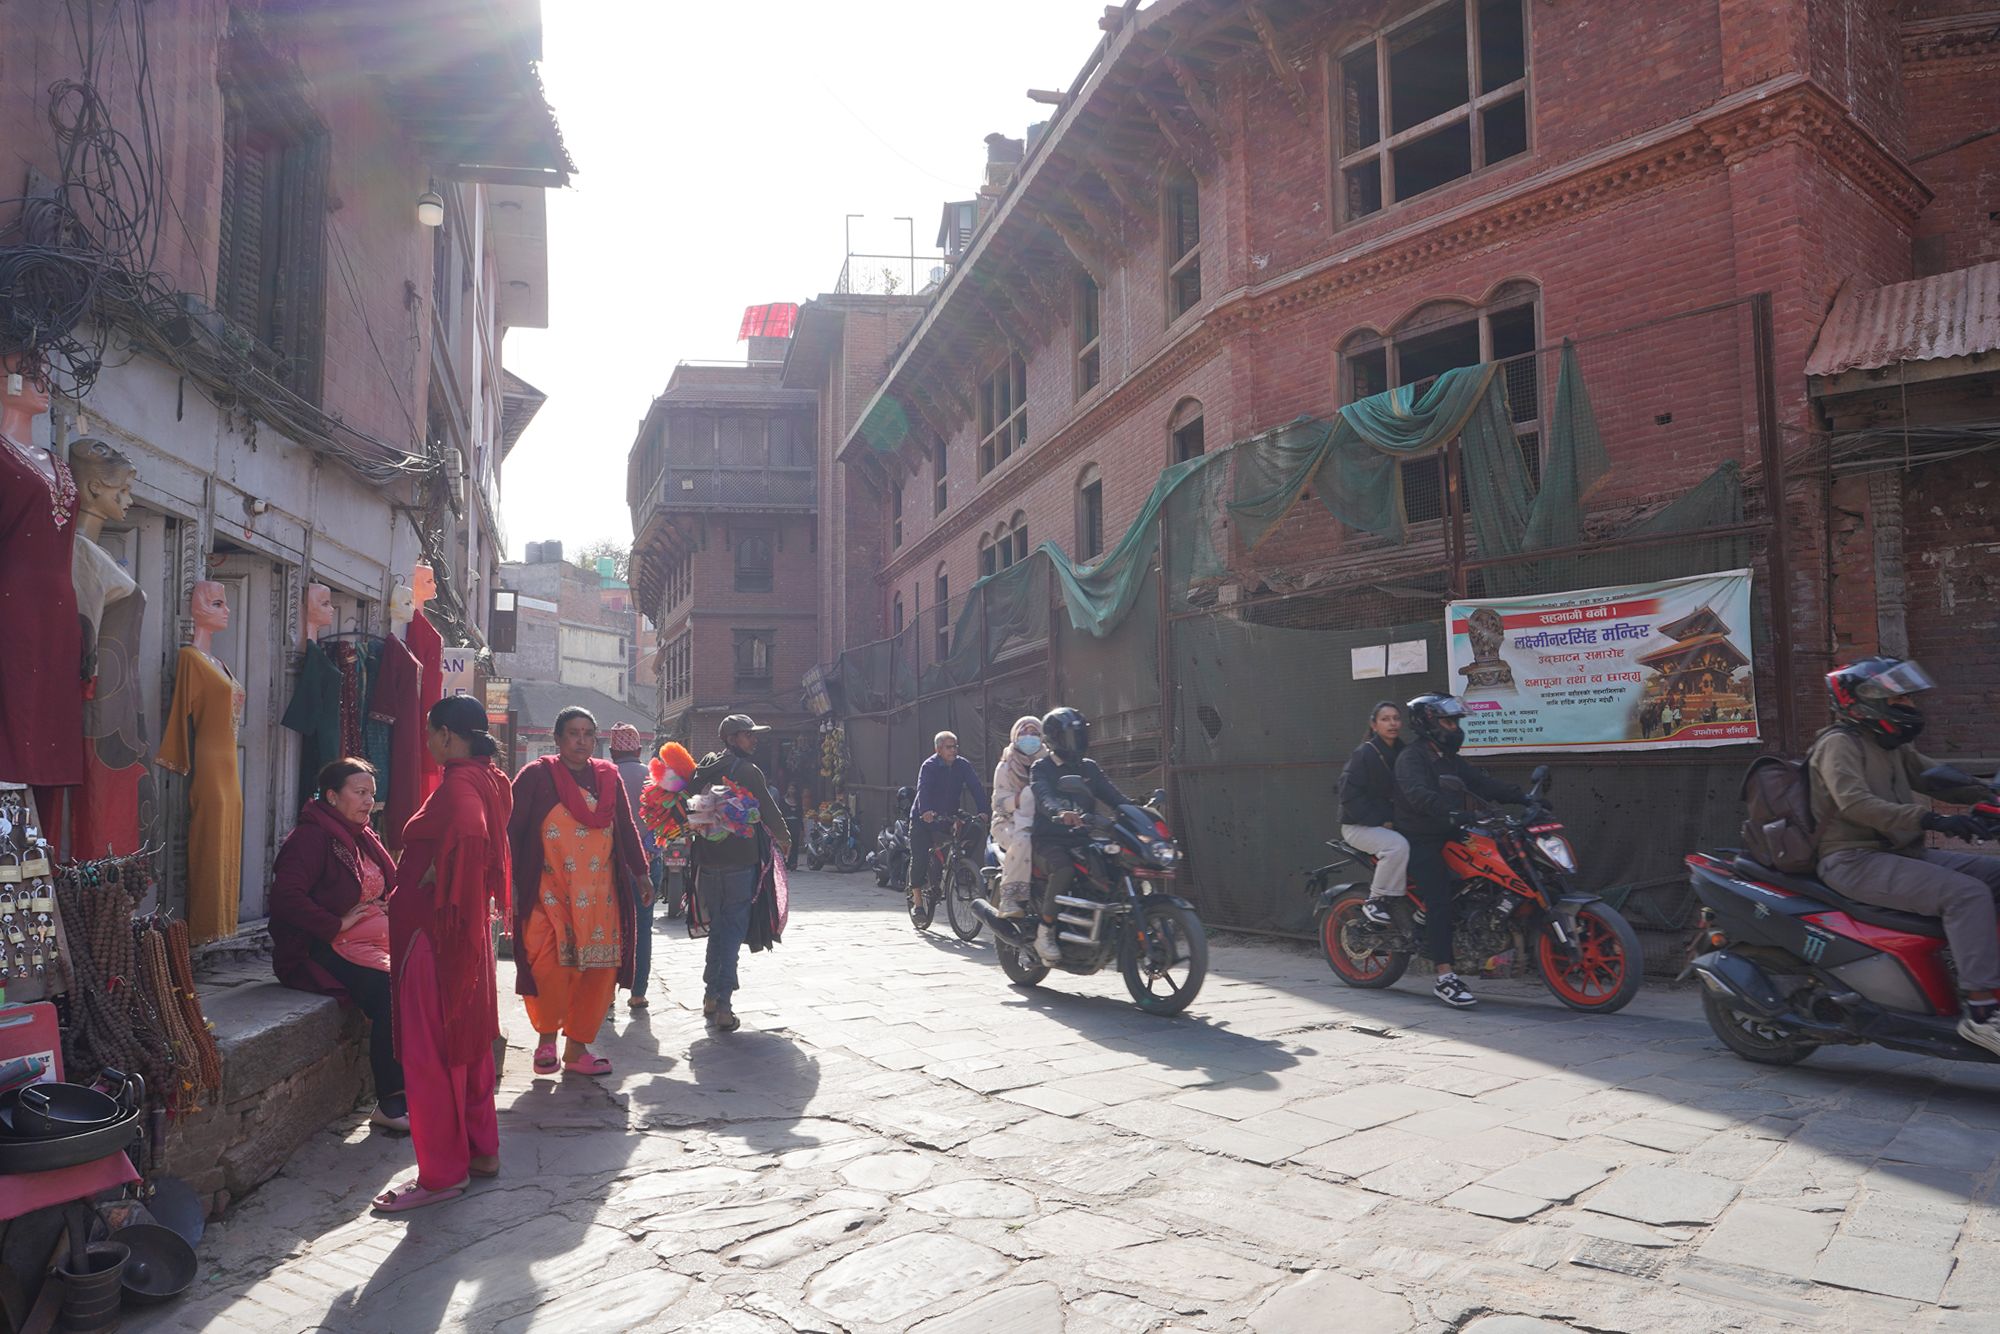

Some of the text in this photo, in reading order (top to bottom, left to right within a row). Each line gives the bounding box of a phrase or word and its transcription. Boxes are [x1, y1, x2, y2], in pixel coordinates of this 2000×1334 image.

[1539, 608, 1583, 624] सहभागी
[1514, 622, 1650, 649] लक्ष्मीनरसिंह मन्दिर
[1584, 648, 1625, 661] समारोह
[1578, 664, 1584, 672] र
[1524, 677, 1562, 689] क्षमापूजा
[1566, 675, 1586, 685] तथा
[1726, 725, 1749, 735] समिति
[1447, 847, 1529, 893] DUKE
